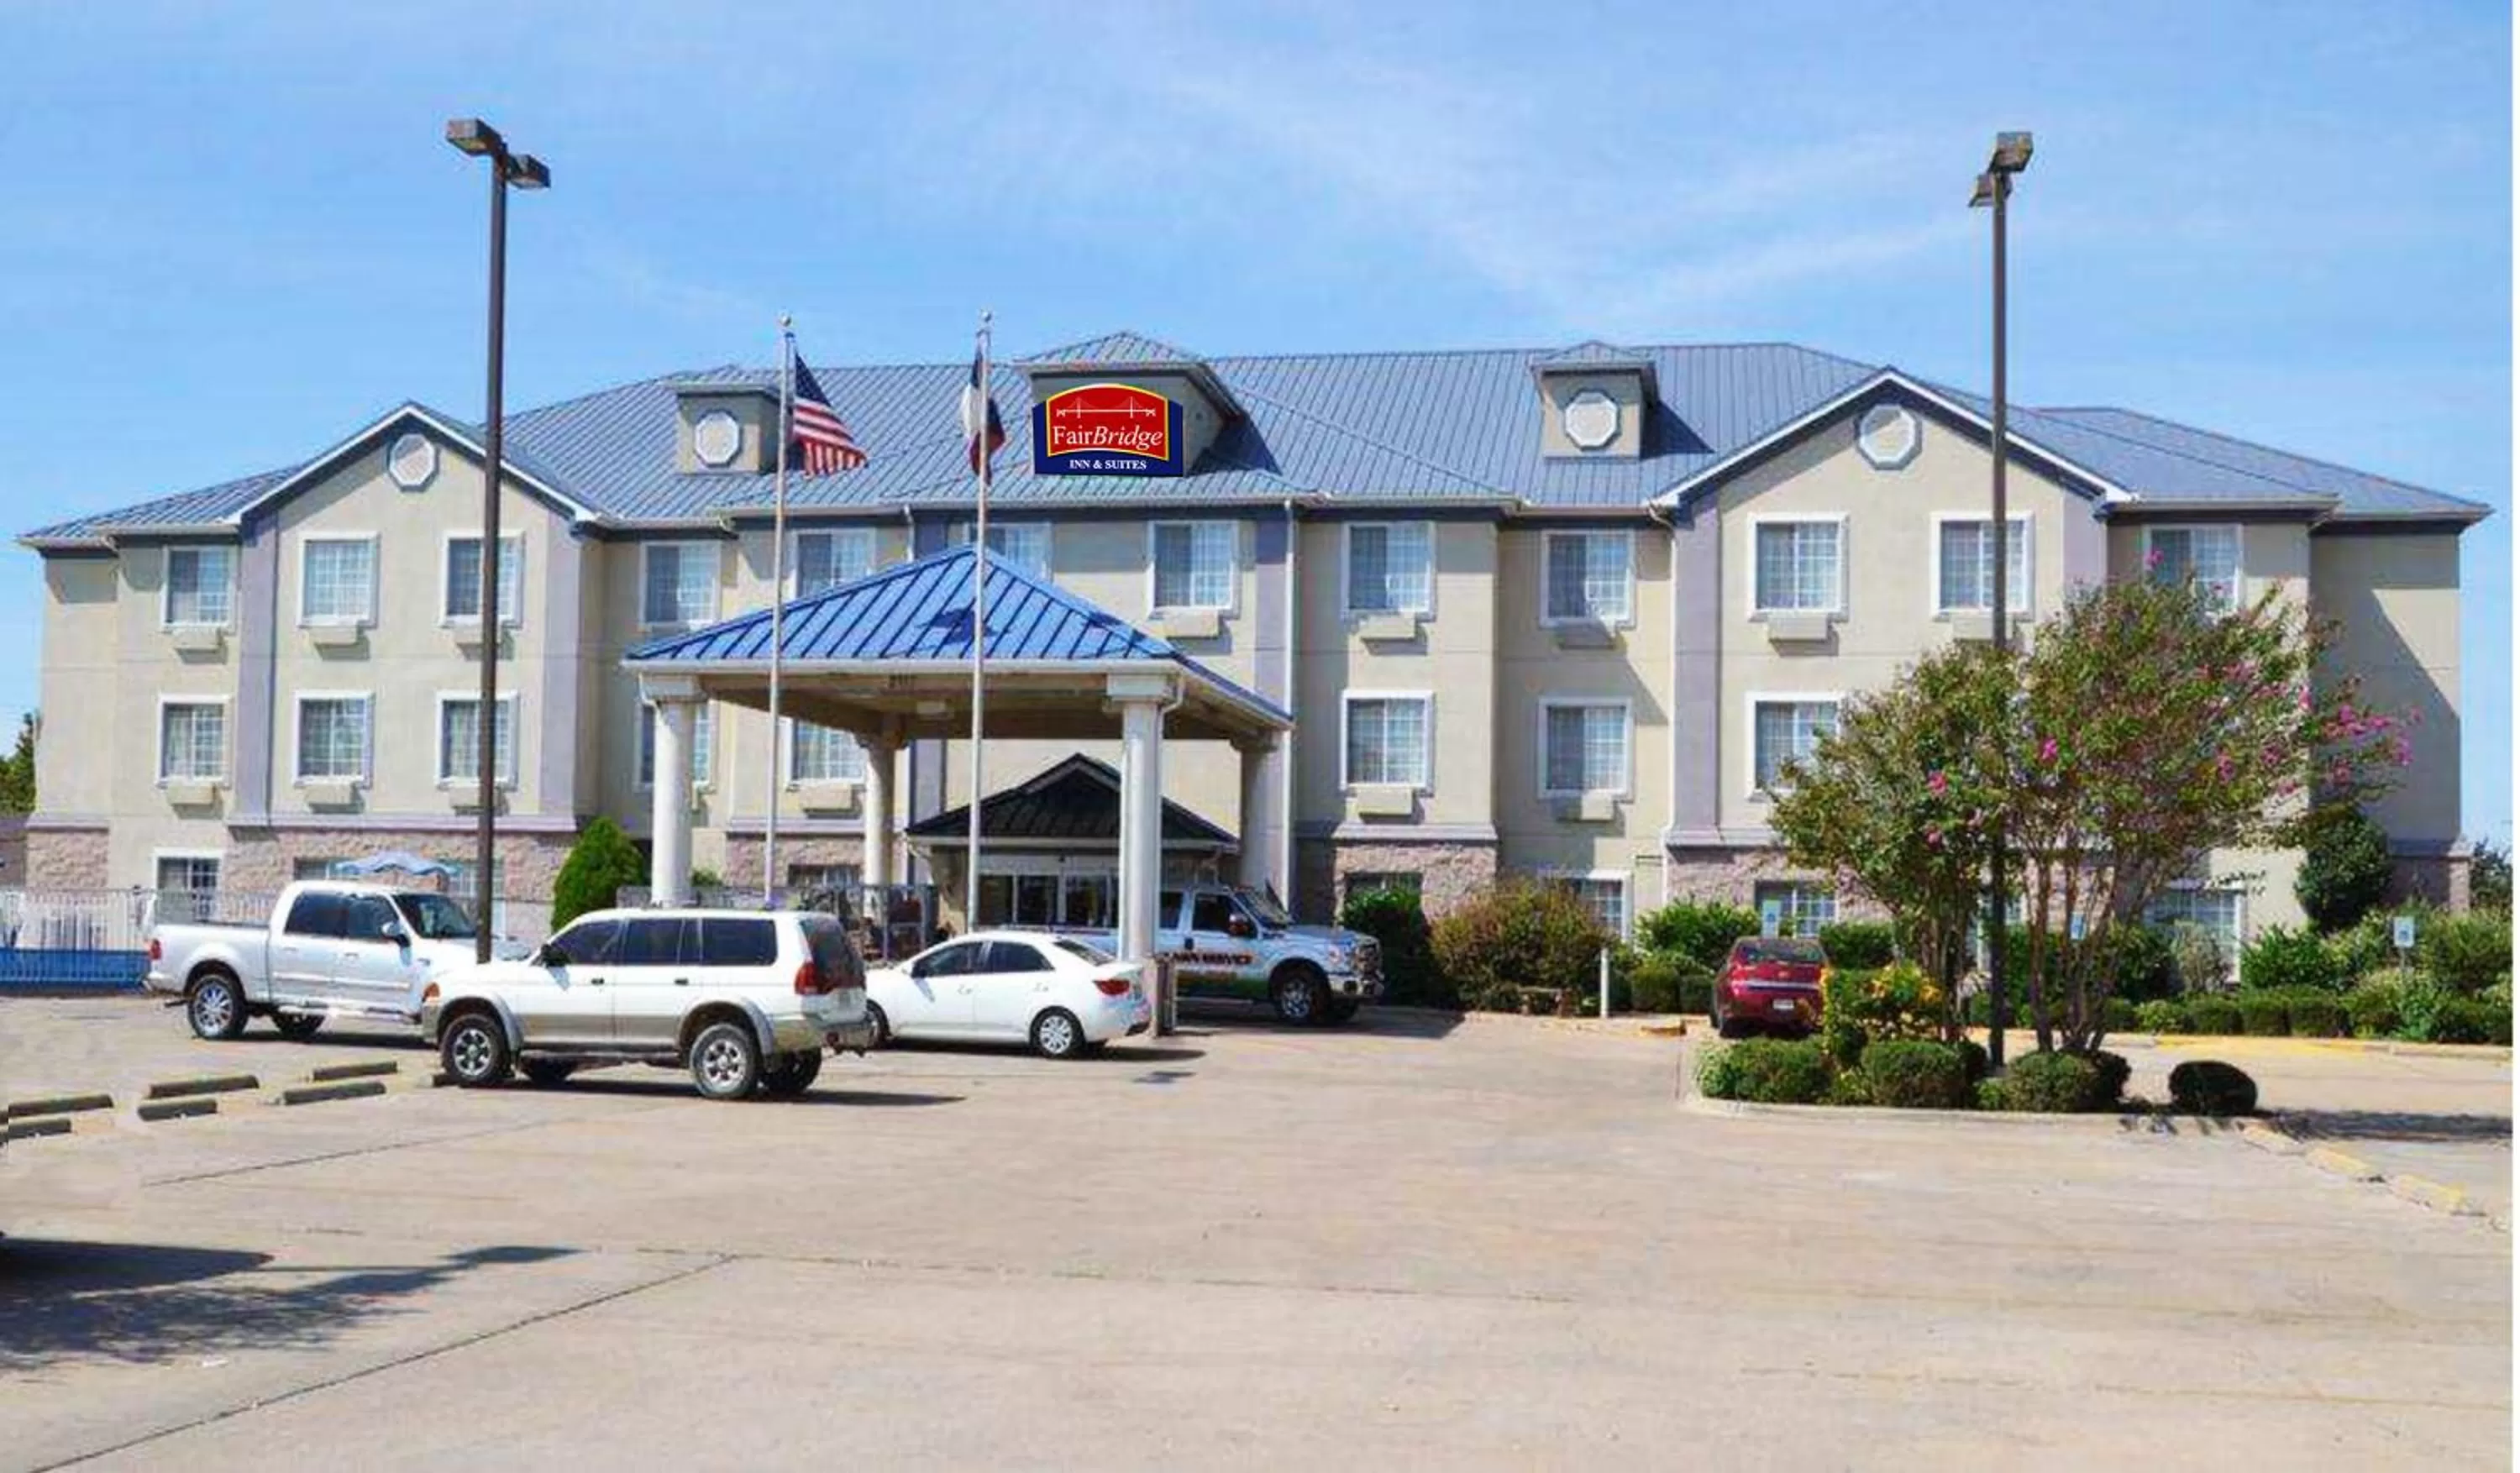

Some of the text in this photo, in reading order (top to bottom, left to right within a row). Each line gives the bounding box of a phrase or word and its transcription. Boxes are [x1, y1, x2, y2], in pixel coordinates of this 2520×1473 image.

[1053, 425, 1163, 450] FairBridge
[1069, 459, 1147, 469] INN & SUITES
